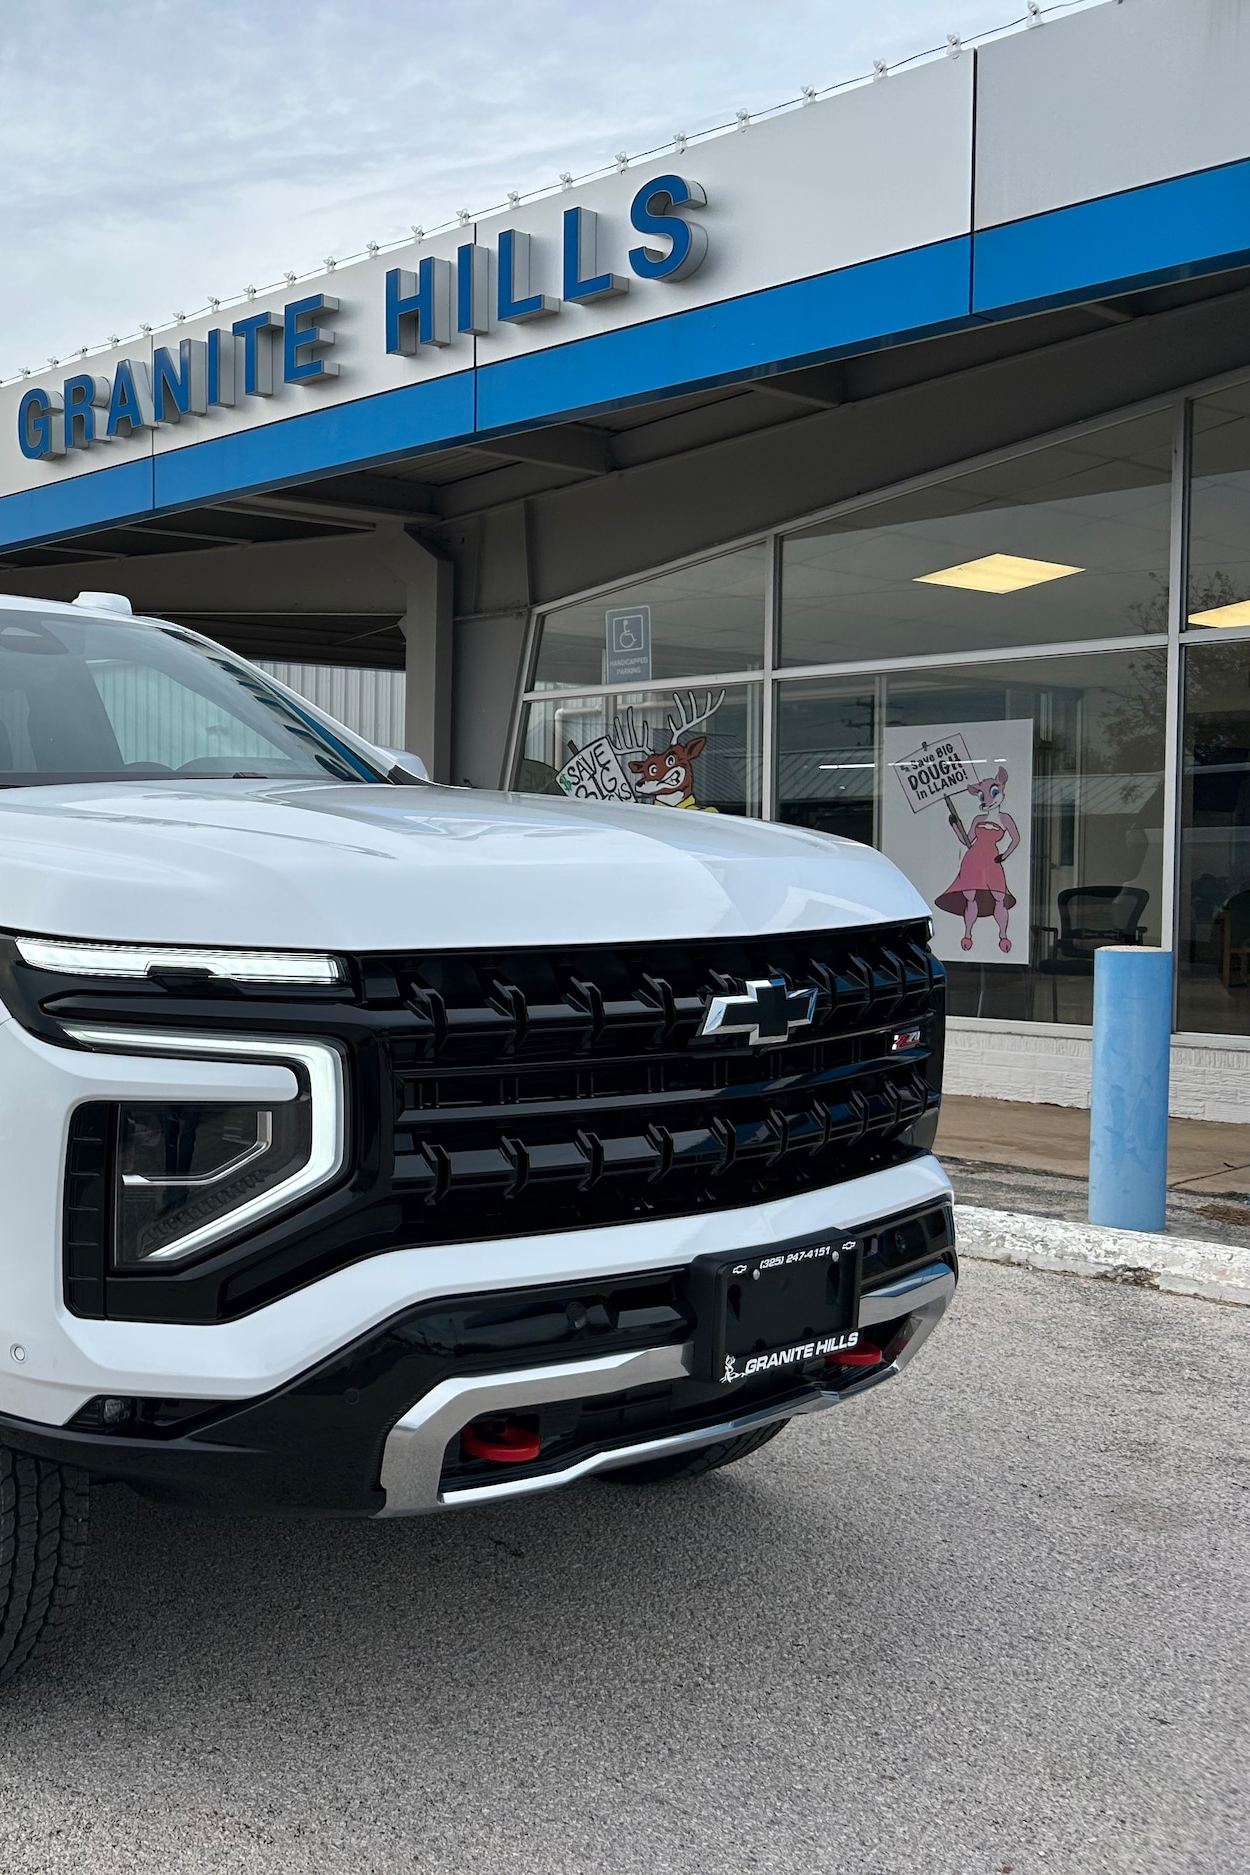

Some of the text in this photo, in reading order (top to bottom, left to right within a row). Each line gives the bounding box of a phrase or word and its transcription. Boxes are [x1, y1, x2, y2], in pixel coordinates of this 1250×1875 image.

[18, 174, 706, 461] GRANITE HILLS
[610, 656, 649, 666] HANDICAPPED
[616, 667, 642, 675] PARKING
[567, 743, 611, 786] SAVE
[910, 743, 954, 770] Save BIG
[907, 753, 963, 791] DOUGH
[927, 768, 968, 795] LLANO!
[892, 1030, 921, 1050] Z71
[759, 1245, 831, 1270] (325) 247-4151
[745, 1331, 859, 1375] GRANITE HILLS
